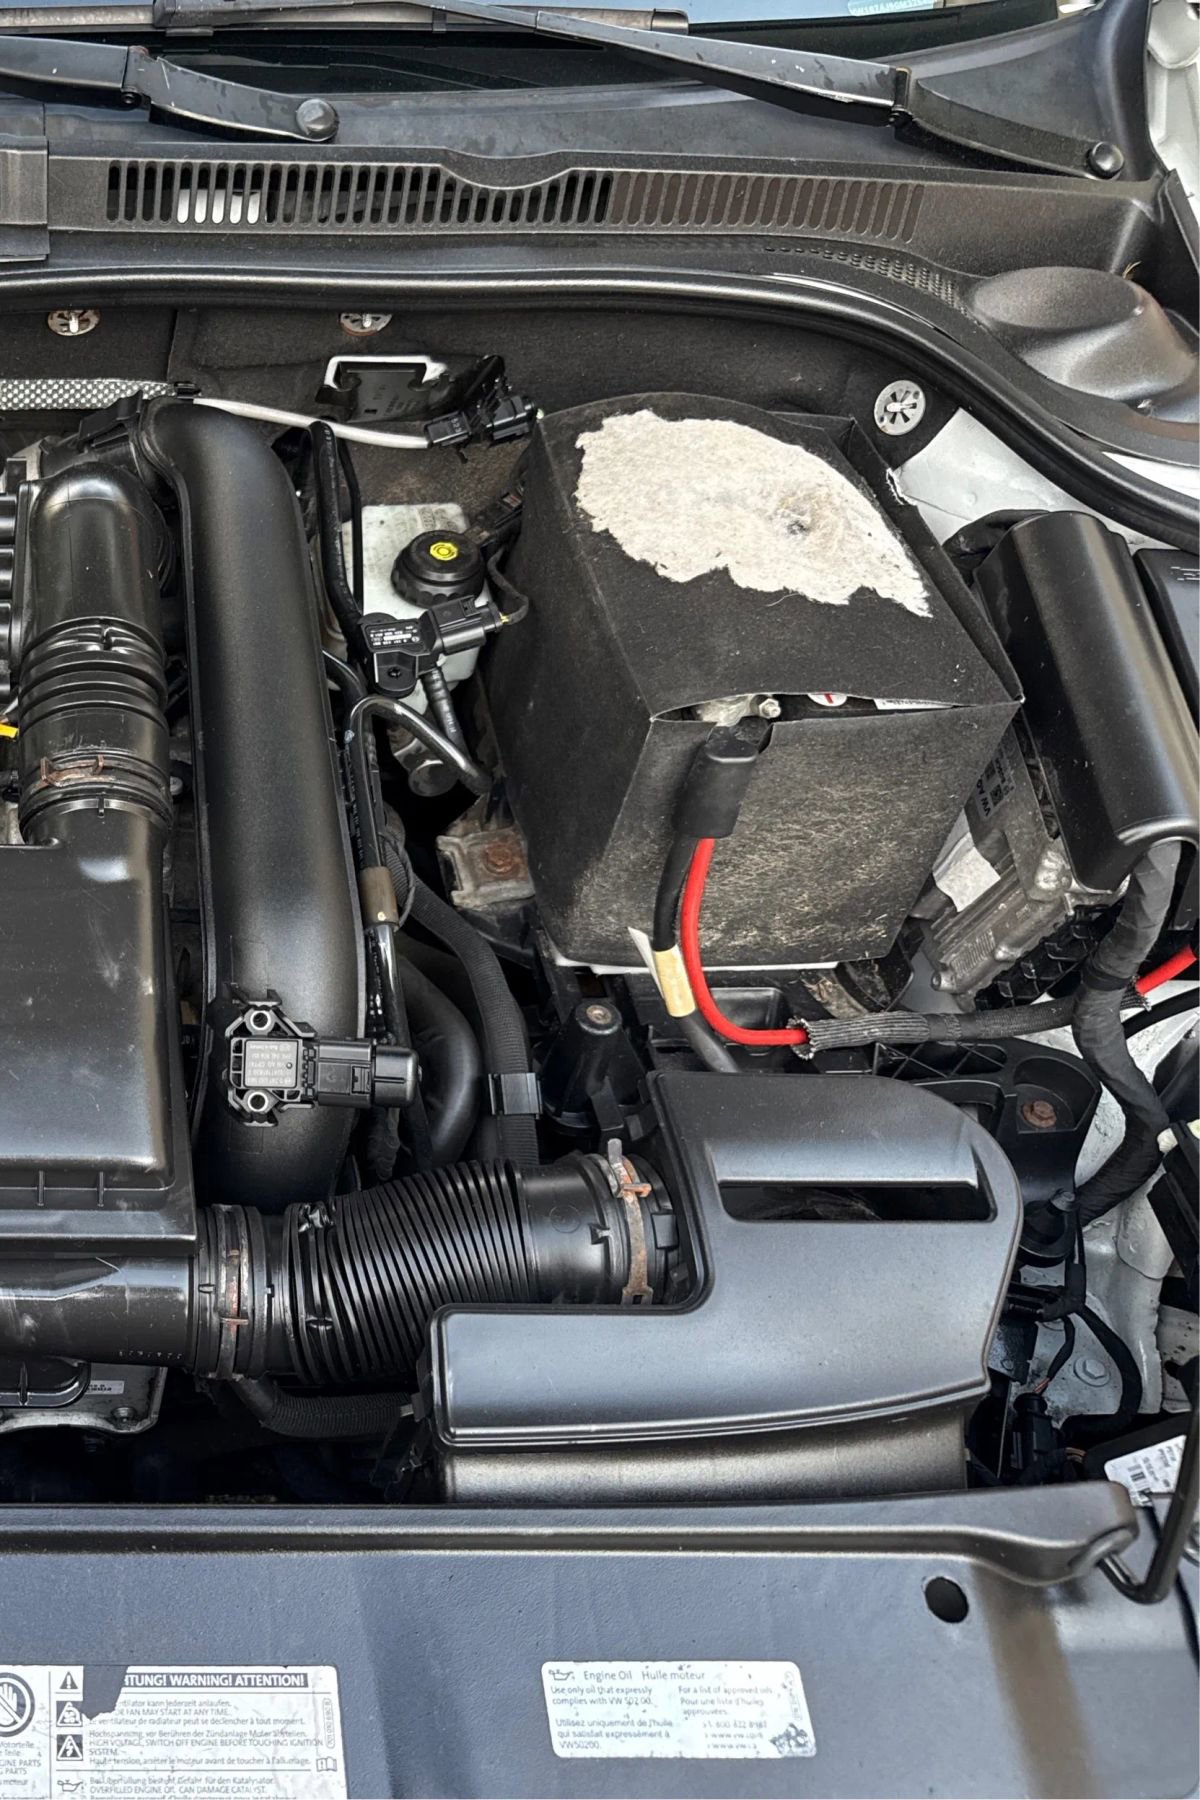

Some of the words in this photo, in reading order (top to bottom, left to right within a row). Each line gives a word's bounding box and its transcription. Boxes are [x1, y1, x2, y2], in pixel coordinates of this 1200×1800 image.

[170, 1674, 232, 1686] WARNING!
[235, 1674, 304, 1686] ATTENTION!
[584, 1670, 616, 1683] Engine
[618, 1670, 632, 1680] Oil
[670, 1671, 705, 1680] moteur
[551, 1686, 566, 1694] Use
[567, 1686, 584, 1696] only
[586, 1686, 595, 1694] oil
[597, 1686, 614, 1694] that
[616, 1686, 652, 1696] expressly
[552, 1696, 588, 1706] complies
[590, 1696, 607, 1705] with
[608, 1696, 622, 1705] VW
[587, 1719, 635, 1729] uniquement
[637, 1719, 646, 1727] de
[557, 1730, 570, 1739] qui
